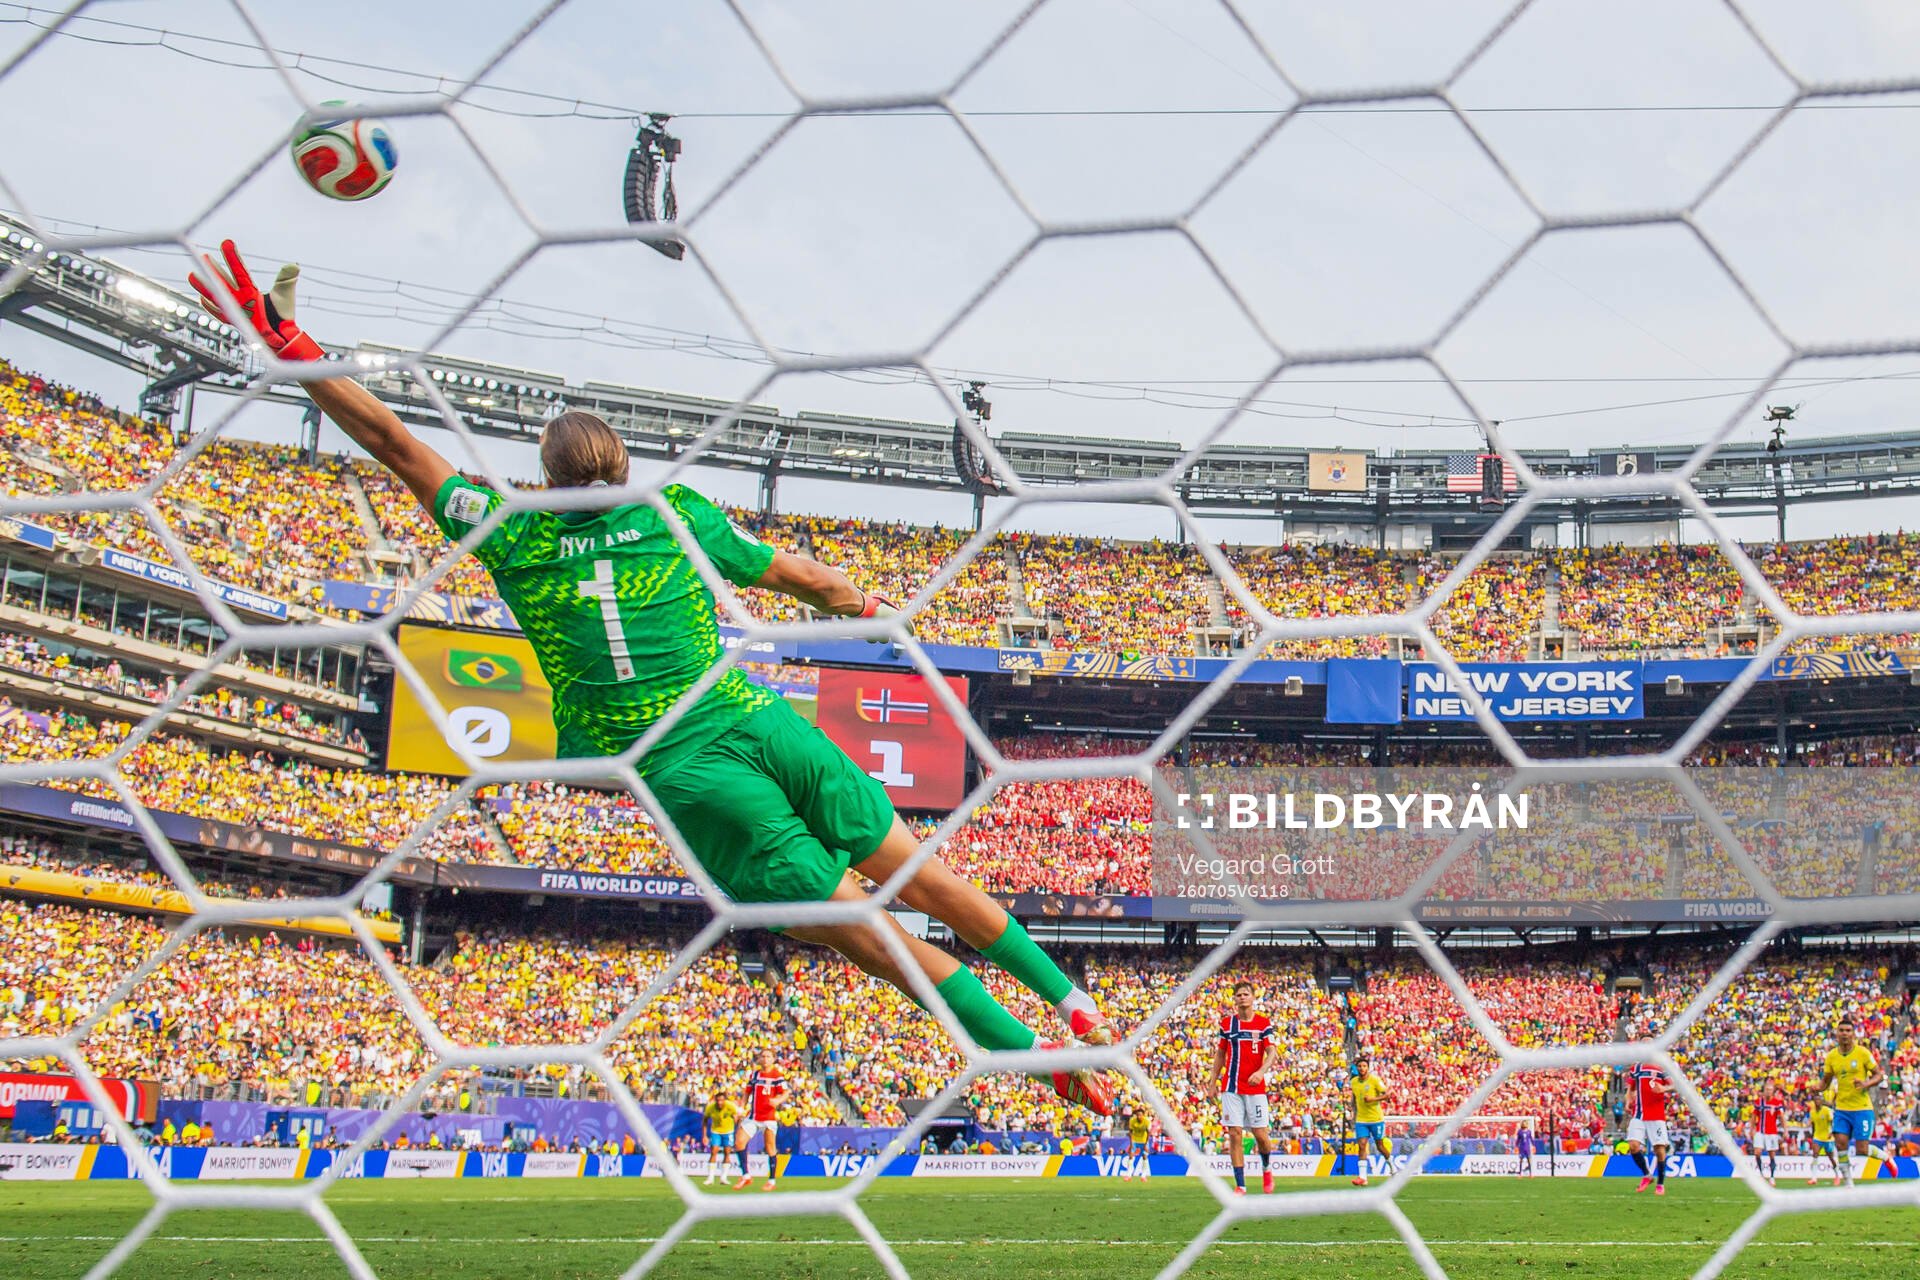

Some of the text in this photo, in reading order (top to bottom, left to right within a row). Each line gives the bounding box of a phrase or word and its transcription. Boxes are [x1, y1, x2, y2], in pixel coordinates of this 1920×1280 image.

[112, 553, 147, 575] NEW
[150, 566, 189, 588] YORK
[225, 589, 281, 613] JERSEY
[579, 559, 637, 681] 1
[1518, 670, 1634, 692] YORK
[1499, 696, 1634, 716] JERSEY
[869, 740, 914, 787] 1
[71, 801, 134, 827] #FIFAWorldCup
[541, 873, 578, 889] FIFA
[581, 876, 642, 893] WORLD
[644, 880, 679, 895] CUP
[1190, 903, 1242, 914] #FIFAWorldC
[1422, 906, 1450, 917] NEW
[1490, 906, 1520, 917] NEW
[1522, 906, 1572, 917] JERSEY
[1684, 903, 1775, 917] FIFA WORLD
[0, 1082, 69, 1107] ORWAY
[1255, 1105, 1262, 1118] 5
[210, 1157, 256, 1169] MARRIOTT
[481, 1152, 508, 1177] VISA
[818, 1155, 878, 1177] VISA
[925, 1161, 985, 1170] MARRIOTT
[1092, 1155, 1151, 1177] VISA
[1271, 1160, 1312, 1170] ONVOY
[1644, 1155, 1697, 1178] VSA
